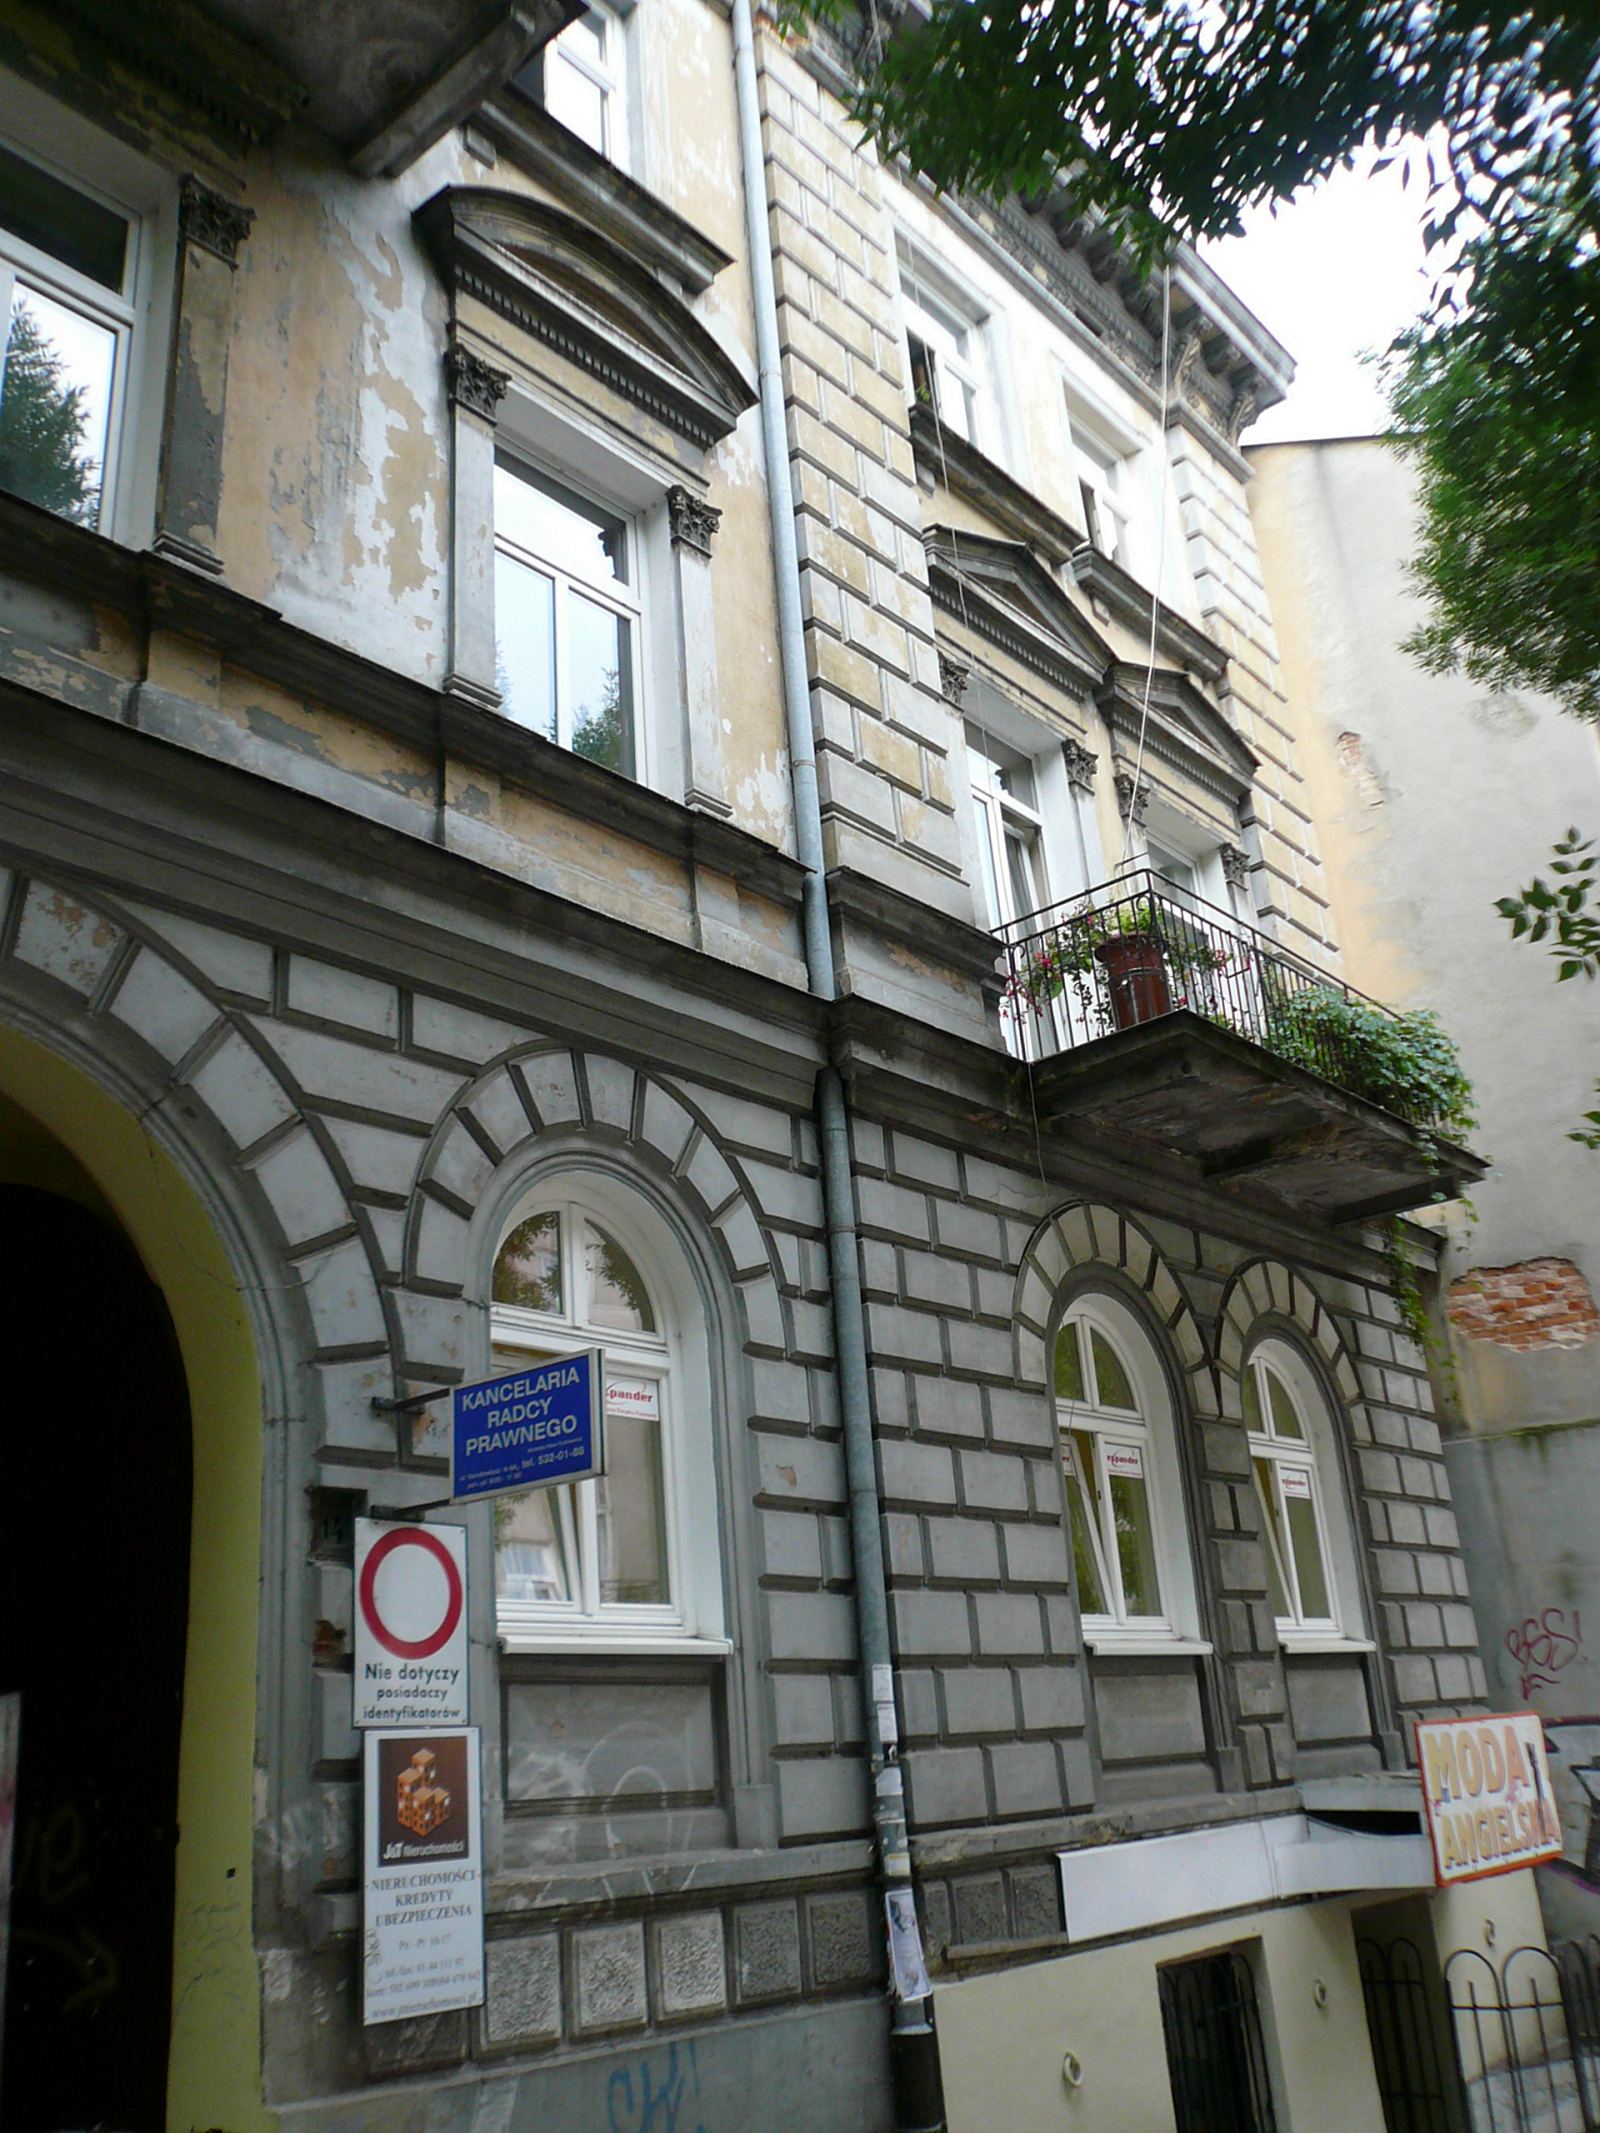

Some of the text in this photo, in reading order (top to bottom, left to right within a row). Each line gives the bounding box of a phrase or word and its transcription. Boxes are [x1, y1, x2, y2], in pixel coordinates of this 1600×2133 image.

[462, 1366, 580, 1412] KANCELARIA
[606, 1389, 653, 1403] pander
[487, 1396, 553, 1429] RADCY
[465, 1414, 578, 1457] PRAWNEGO
[365, 1663, 460, 1685] Nie dotyczy
[377, 1685, 448, 1701] posiadaczy
[363, 1705, 460, 1722] identyfikatorów
[1424, 1726, 1531, 1804] MODA
[1441, 1799, 1561, 1870] ANGIELSKA
[372, 1868, 476, 1892] NIERUCHOMOŚCI
[395, 1889, 454, 1907] KREDYTY
[375, 1905, 472, 1928] UBEZPIECZENIA
